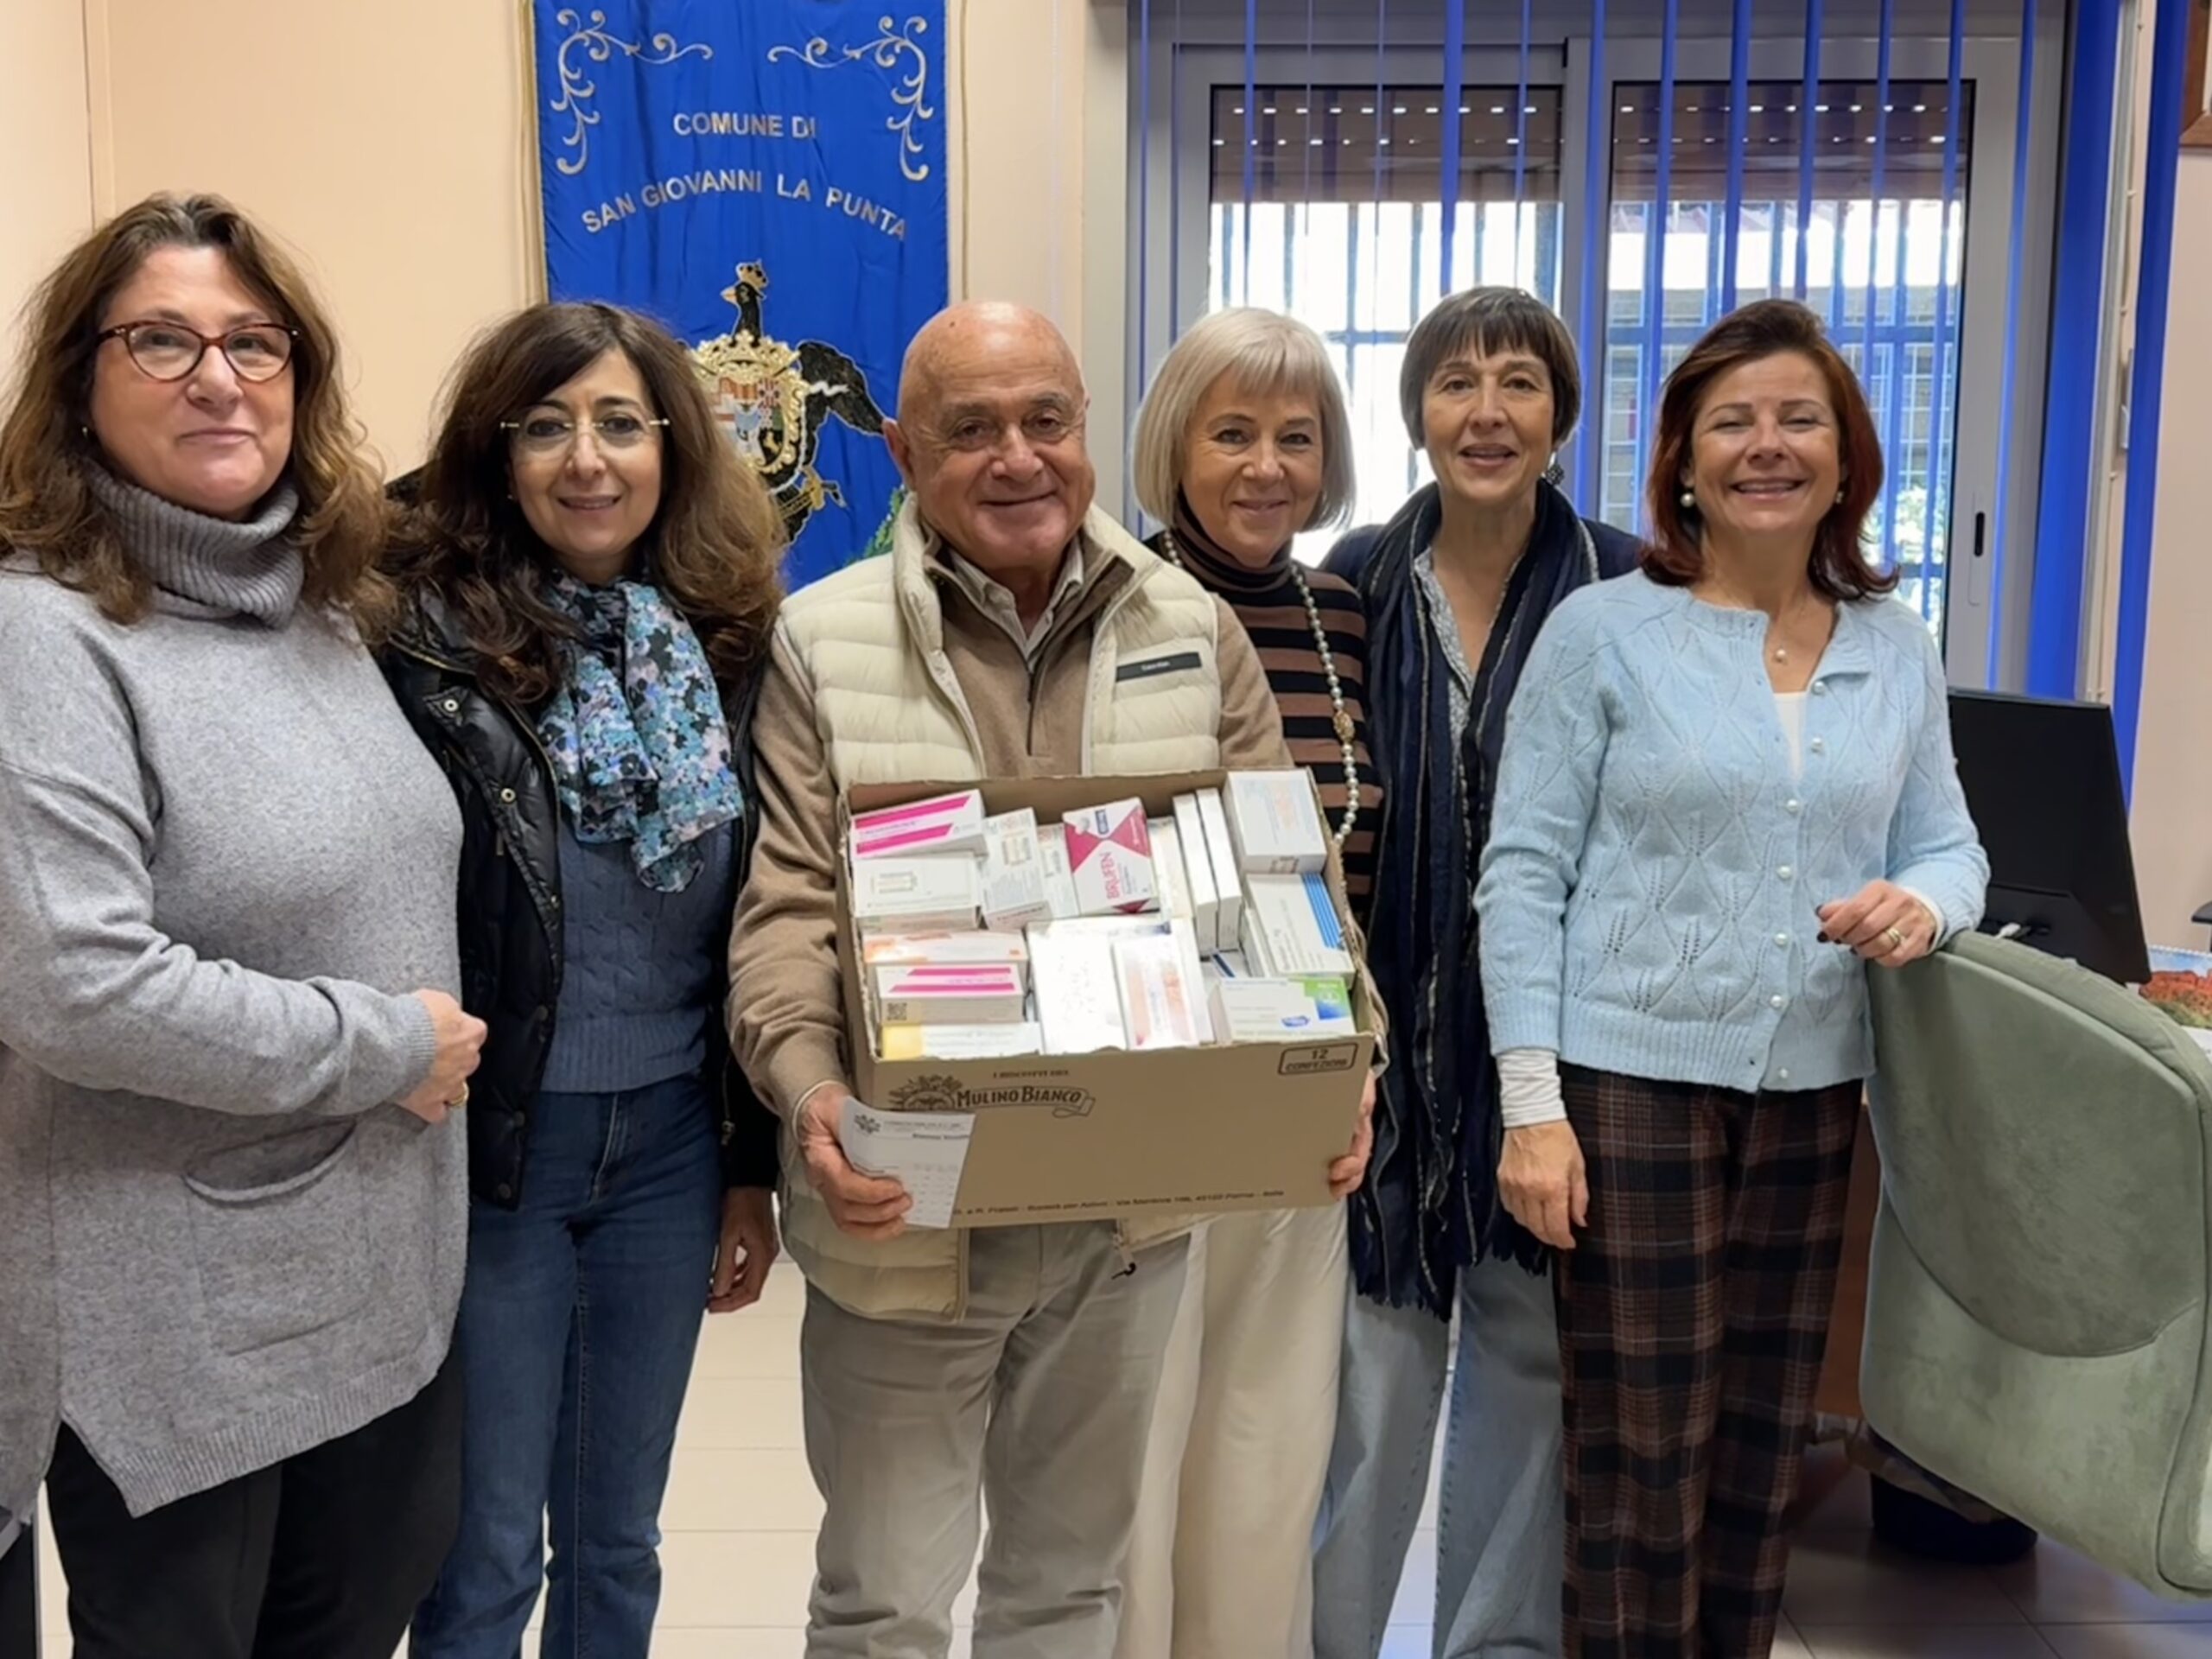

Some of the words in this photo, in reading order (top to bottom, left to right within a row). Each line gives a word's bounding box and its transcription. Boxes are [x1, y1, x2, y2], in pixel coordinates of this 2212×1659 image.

[673, 113, 784, 137] COMUNE
[791, 116, 817, 138] DI
[582, 192, 636, 234] SAN
[641, 169, 762, 208] GIOVANNI
[777, 174, 811, 201] LA
[826, 188, 906, 242] PUNTA
[1099, 851, 1121, 899] BRUFEN
[1312, 1048, 1329, 1059] 12
[957, 1090, 1019, 1108] MULINO
[1021, 1085, 1082, 1103] BIANCO
